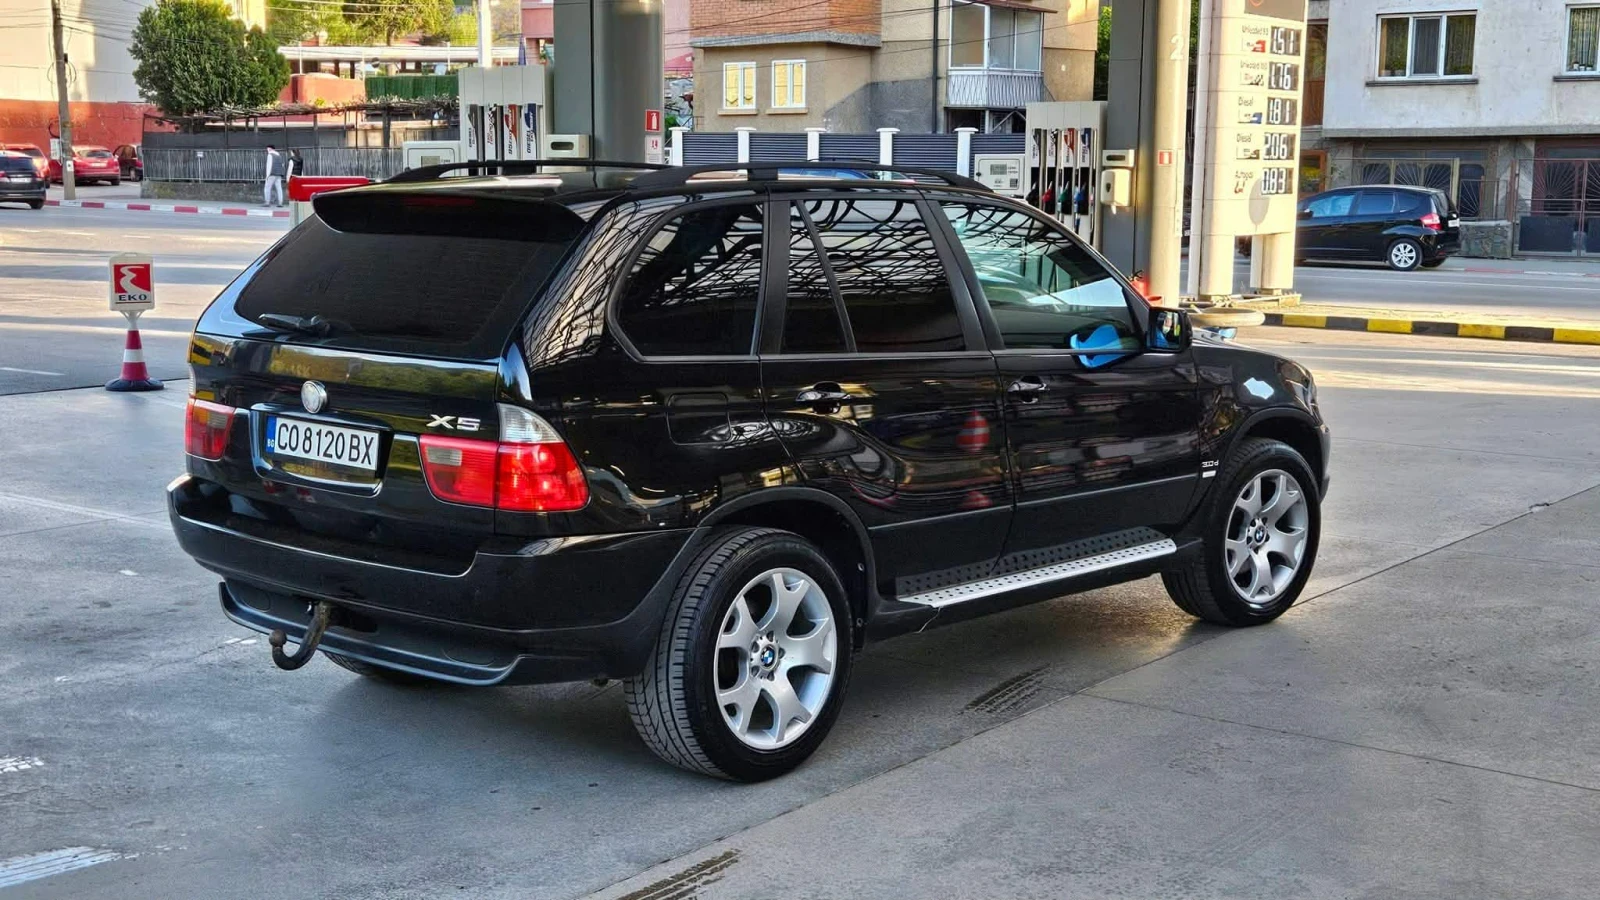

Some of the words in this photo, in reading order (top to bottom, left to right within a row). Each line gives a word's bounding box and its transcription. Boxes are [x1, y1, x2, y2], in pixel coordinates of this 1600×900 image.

[1170, 34, 1184, 60] 2
[1238, 96, 1253, 106] Diesel
[1237, 132, 1251, 143] Diesel
[118, 294, 148, 302] EKO
[426, 414, 481, 431] X5
[267, 438, 274, 448] BG
